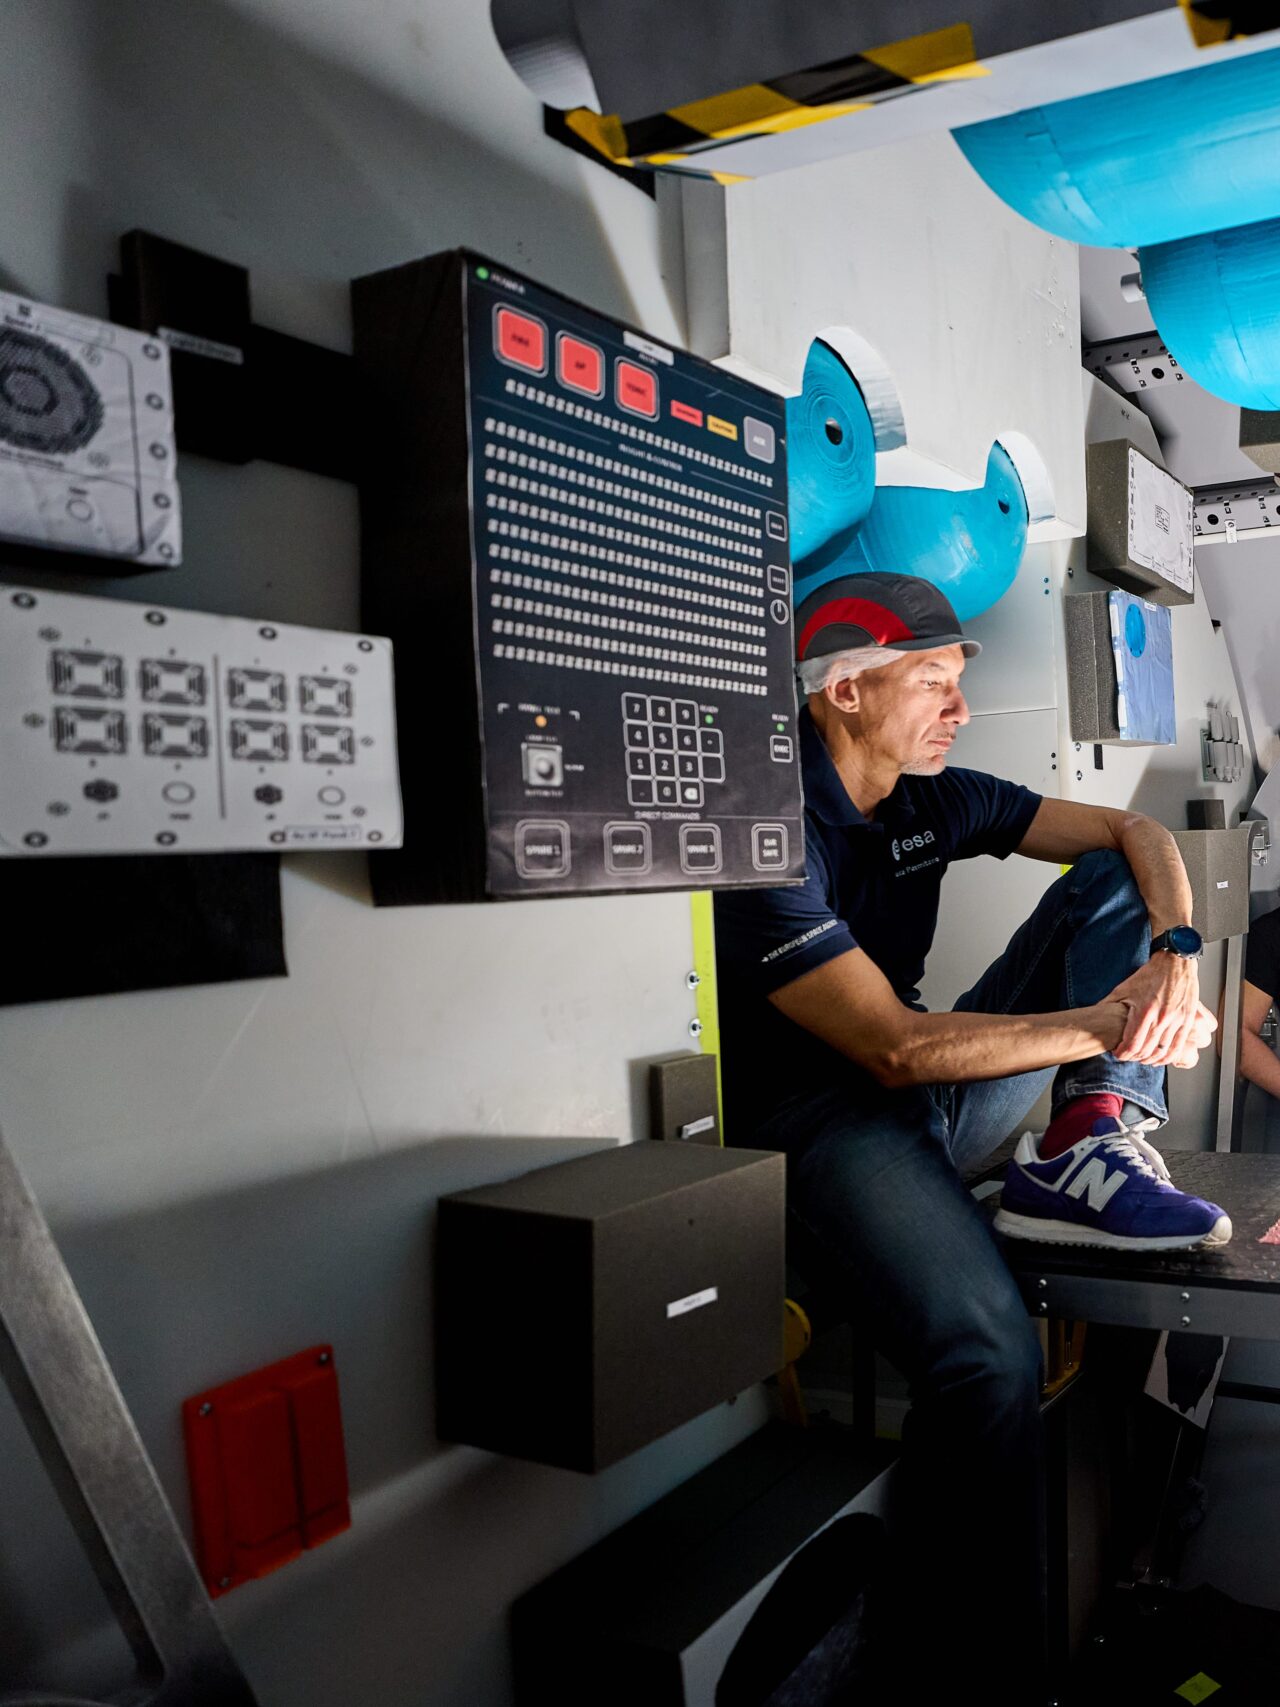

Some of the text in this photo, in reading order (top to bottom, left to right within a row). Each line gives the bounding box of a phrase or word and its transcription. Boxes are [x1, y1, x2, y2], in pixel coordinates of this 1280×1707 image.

[633, 702, 640, 713] 7
[658, 706, 665, 717] 8
[682, 709, 689, 719] 9
[634, 730, 642, 741] 4
[659, 733, 667, 743] 5
[684, 735, 691, 746] 6
[637, 759, 644, 770] 1
[661, 760, 669, 771] 2
[686, 762, 693, 772] 3
[663, 786, 671, 797] 0
[902, 831, 935, 851] esa
[768, 919, 839, 960] THE EUROPEAN SPACE AGENCY
[1065, 1157, 1128, 1212] N
